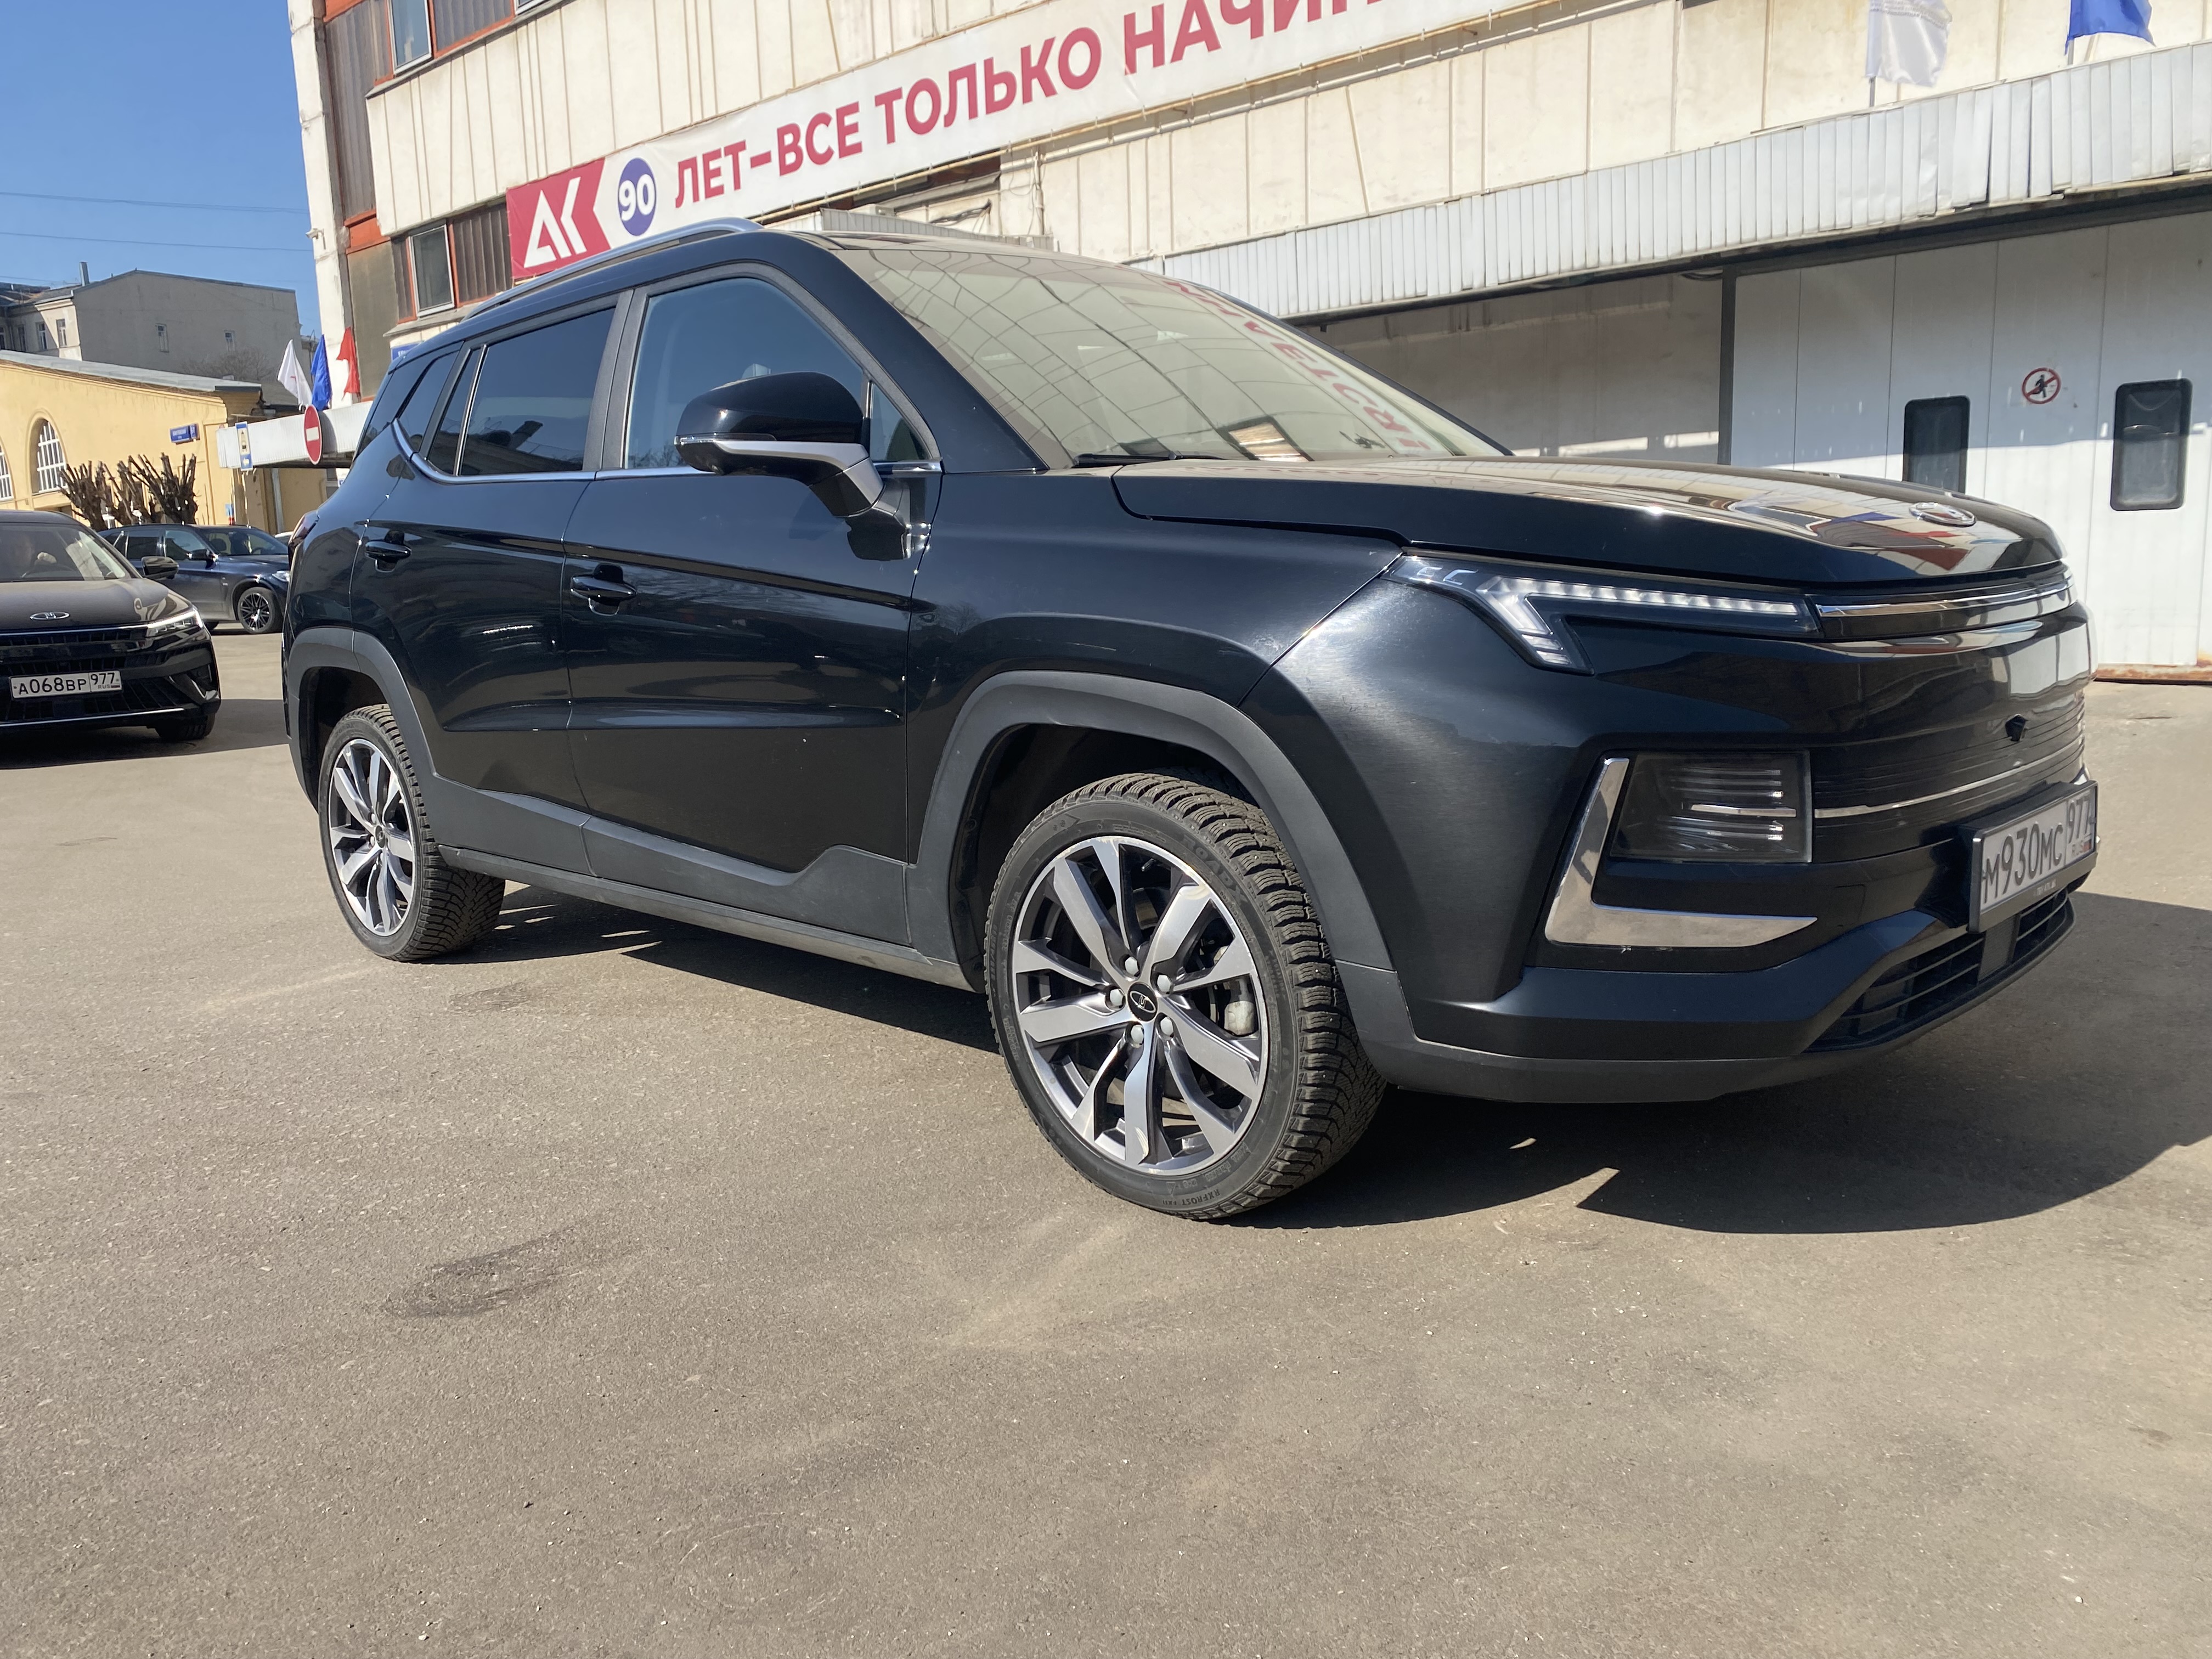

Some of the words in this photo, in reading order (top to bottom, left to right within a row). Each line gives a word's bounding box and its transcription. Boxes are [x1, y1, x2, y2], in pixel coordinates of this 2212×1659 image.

[619, 173, 656, 222] 90
[874, 26, 1102, 145] ТОЛЬКО
[1123, 0, 1383, 75] НАЧ
[19, 677, 87, 695] А068ВР
[90, 672, 115, 685] 977
[1183, 835, 1248, 903] ROADX
[1984, 822, 2063, 904] М930МС
[2068, 795, 2091, 844] 977
[1181, 1188, 1221, 1206] RXFROST
